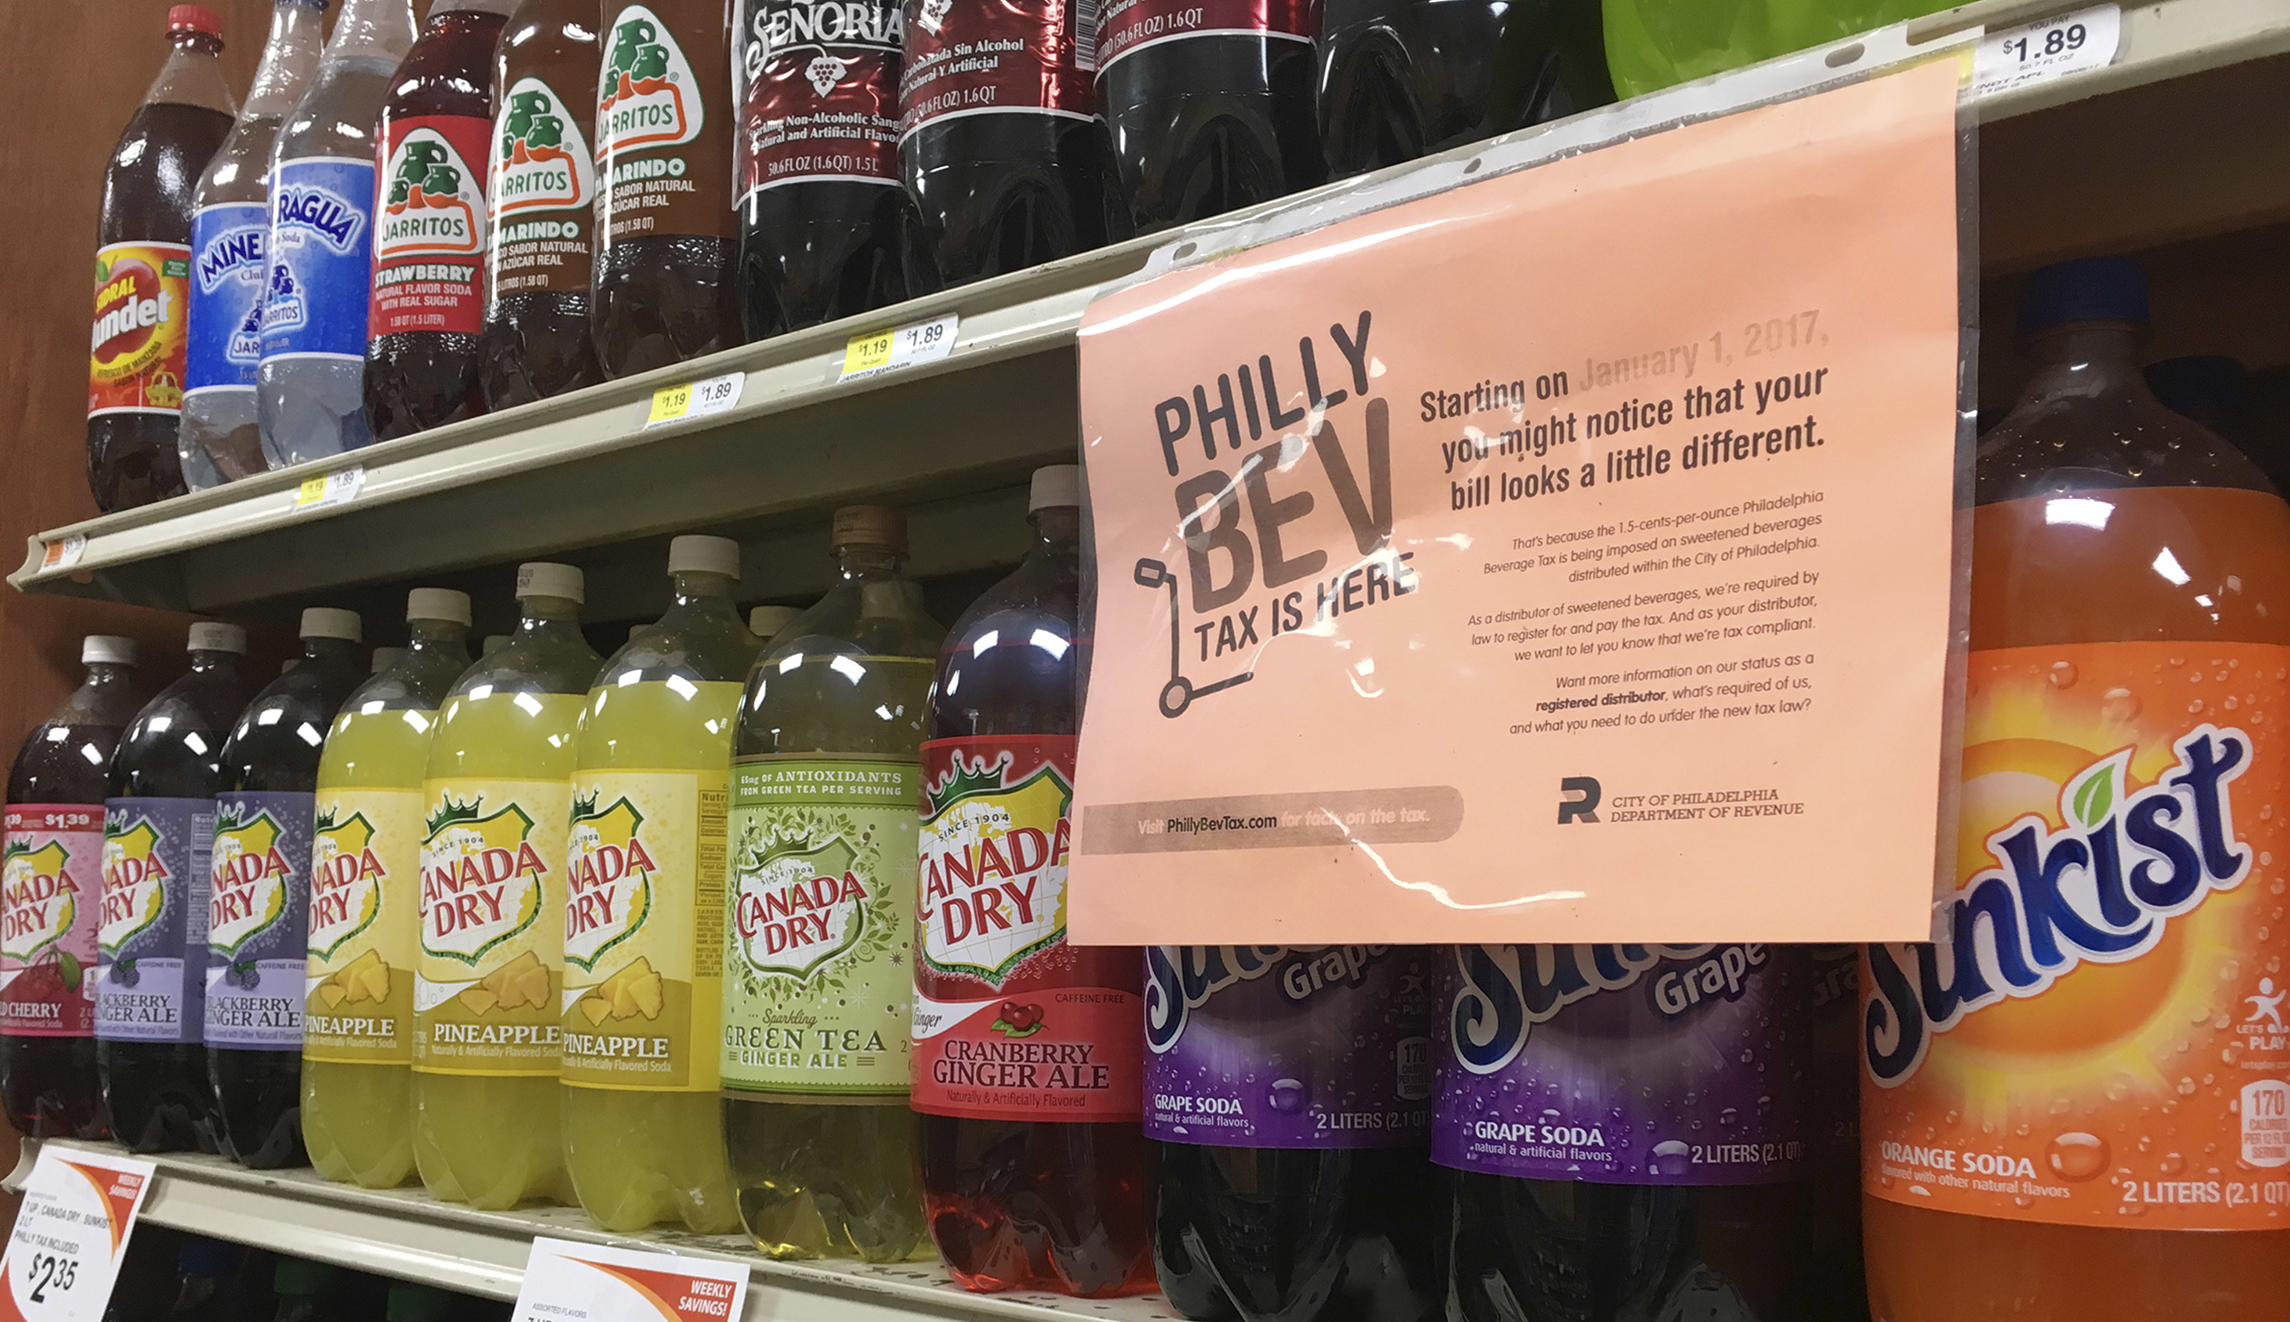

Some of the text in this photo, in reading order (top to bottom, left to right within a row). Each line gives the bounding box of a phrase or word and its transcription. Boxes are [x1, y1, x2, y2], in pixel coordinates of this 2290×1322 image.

[954, 38, 1024, 57] Sin Alcohol
[2003, 23, 2087, 63] $1.89
[786, 112, 868, 127] Non-Alcoholic
[614, 180, 697, 200] SABOR NATURAL
[383, 217, 464, 242] JARRITOS
[375, 265, 476, 289] STRAWBERRY
[376, 283, 472, 301] NATURAL FLAVOR SODA
[381, 296, 458, 311] WITH REAL SUGAR
[859, 324, 944, 357] $1.19 $1.89
[1420, 309, 1829, 422] Starting on January 1, 2017,
[662, 382, 732, 408] $1.19 $1.89
[1155, 310, 1372, 477] PHILLY
[1442, 367, 1829, 474] you might notice that your
[1451, 415, 1825, 511] bill looks a little different.
[1175, 398, 1392, 613] BEV
[1546, 528, 1595, 545] because
[1597, 524, 1616, 537] the
[1619, 505, 1740, 534] 1.5-cents-per-ounce
[1743, 491, 1824, 514] Philadelphia
[1483, 514, 1823, 574] Beverage Tax is being imposed on sweetened beverages
[1568, 536, 1821, 583] distributed within the City of Philadelphia.
[1194, 552, 1416, 662] TAX IS HERE
[1556, 653, 1815, 689] Want more information on our status as a
[1535, 694, 1598, 713] registered
[1601, 690, 1669, 707] distributor,
[1716, 678, 1772, 697] required
[1775, 676, 1790, 690] of
[1793, 677, 1812, 690] us,
[1509, 698, 1812, 735] and what you need to do under the new tax law?
[762, 774, 772, 783] OF
[776, 770, 902, 784] ANTIOXIDANTS
[741, 785, 902, 796] FROM GREEN TEA PER SERVING
[1612, 789, 1779, 808] CITY OF PHILADELPHIA
[45, 814, 90, 829] $1.39
[1138, 820, 1164, 835] Visit
[1167, 814, 1277, 836] PhillyBevTax.com
[1280, 811, 1301, 828] for
[1346, 812, 1365, 825] on
[1370, 807, 1396, 824] the
[1400, 807, 1431, 823] tax.
[1610, 802, 1805, 823] DEPARTMENT OF REVENUE
[432, 836, 485, 858] SINCE 1904
[418, 842, 548, 919] CANADA
[916, 816, 1071, 924] CANADA
[434, 886, 505, 938] DRY
[736, 871, 868, 939] CANADA
[943, 876, 1038, 946] DRY
[1865, 733, 2245, 1079] Sunkist
[764, 909, 832, 955] DRY
[1655, 943, 1767, 1015] Grape
[8, 1002, 62, 1018] CHERRY
[1055, 993, 1125, 1004] CAFFEINE FREE
[257, 1011, 301, 1027] ALE
[305, 1015, 394, 1037] PINEAPPLE
[763, 1007, 818, 1028] Sparkling
[434, 1023, 560, 1045] PINEAPPLE
[563, 1033, 669, 1058] PINEAPPLE
[725, 1025, 888, 1053] GREEN TEA
[741, 1052, 847, 1069] GINGER ALE
[944, 1040, 1095, 1065] CRANBERRY
[933, 1060, 1110, 1089] GINGER ALE
[1155, 1093, 1243, 1115] GRAPE SODA
[2252, 1089, 2285, 1116] 170
[1475, 1121, 1606, 1148] GRAPE SODA
[1474, 1143, 1613, 1163] natural & artificial flavors
[1692, 1143, 1760, 1164] 2 LITERS
[1881, 1141, 2037, 1179] ORANGE SODA
[1914, 1171, 1936, 1184] with
[1938, 1174, 1969, 1188] other
[1972, 1178, 2018, 1194] natural
[2022, 1182, 2071, 1199] flavors
[2123, 1180, 2221, 1203] 2 LITERS
[14, 1229, 79, 1255] PHILLY TAX INCLUDED
[691, 1280, 732, 1298] WEEKLY
[532, 1302, 588, 1319] ASSORTED FLAVORS
[678, 1297, 728, 1317] SAVINGS!
